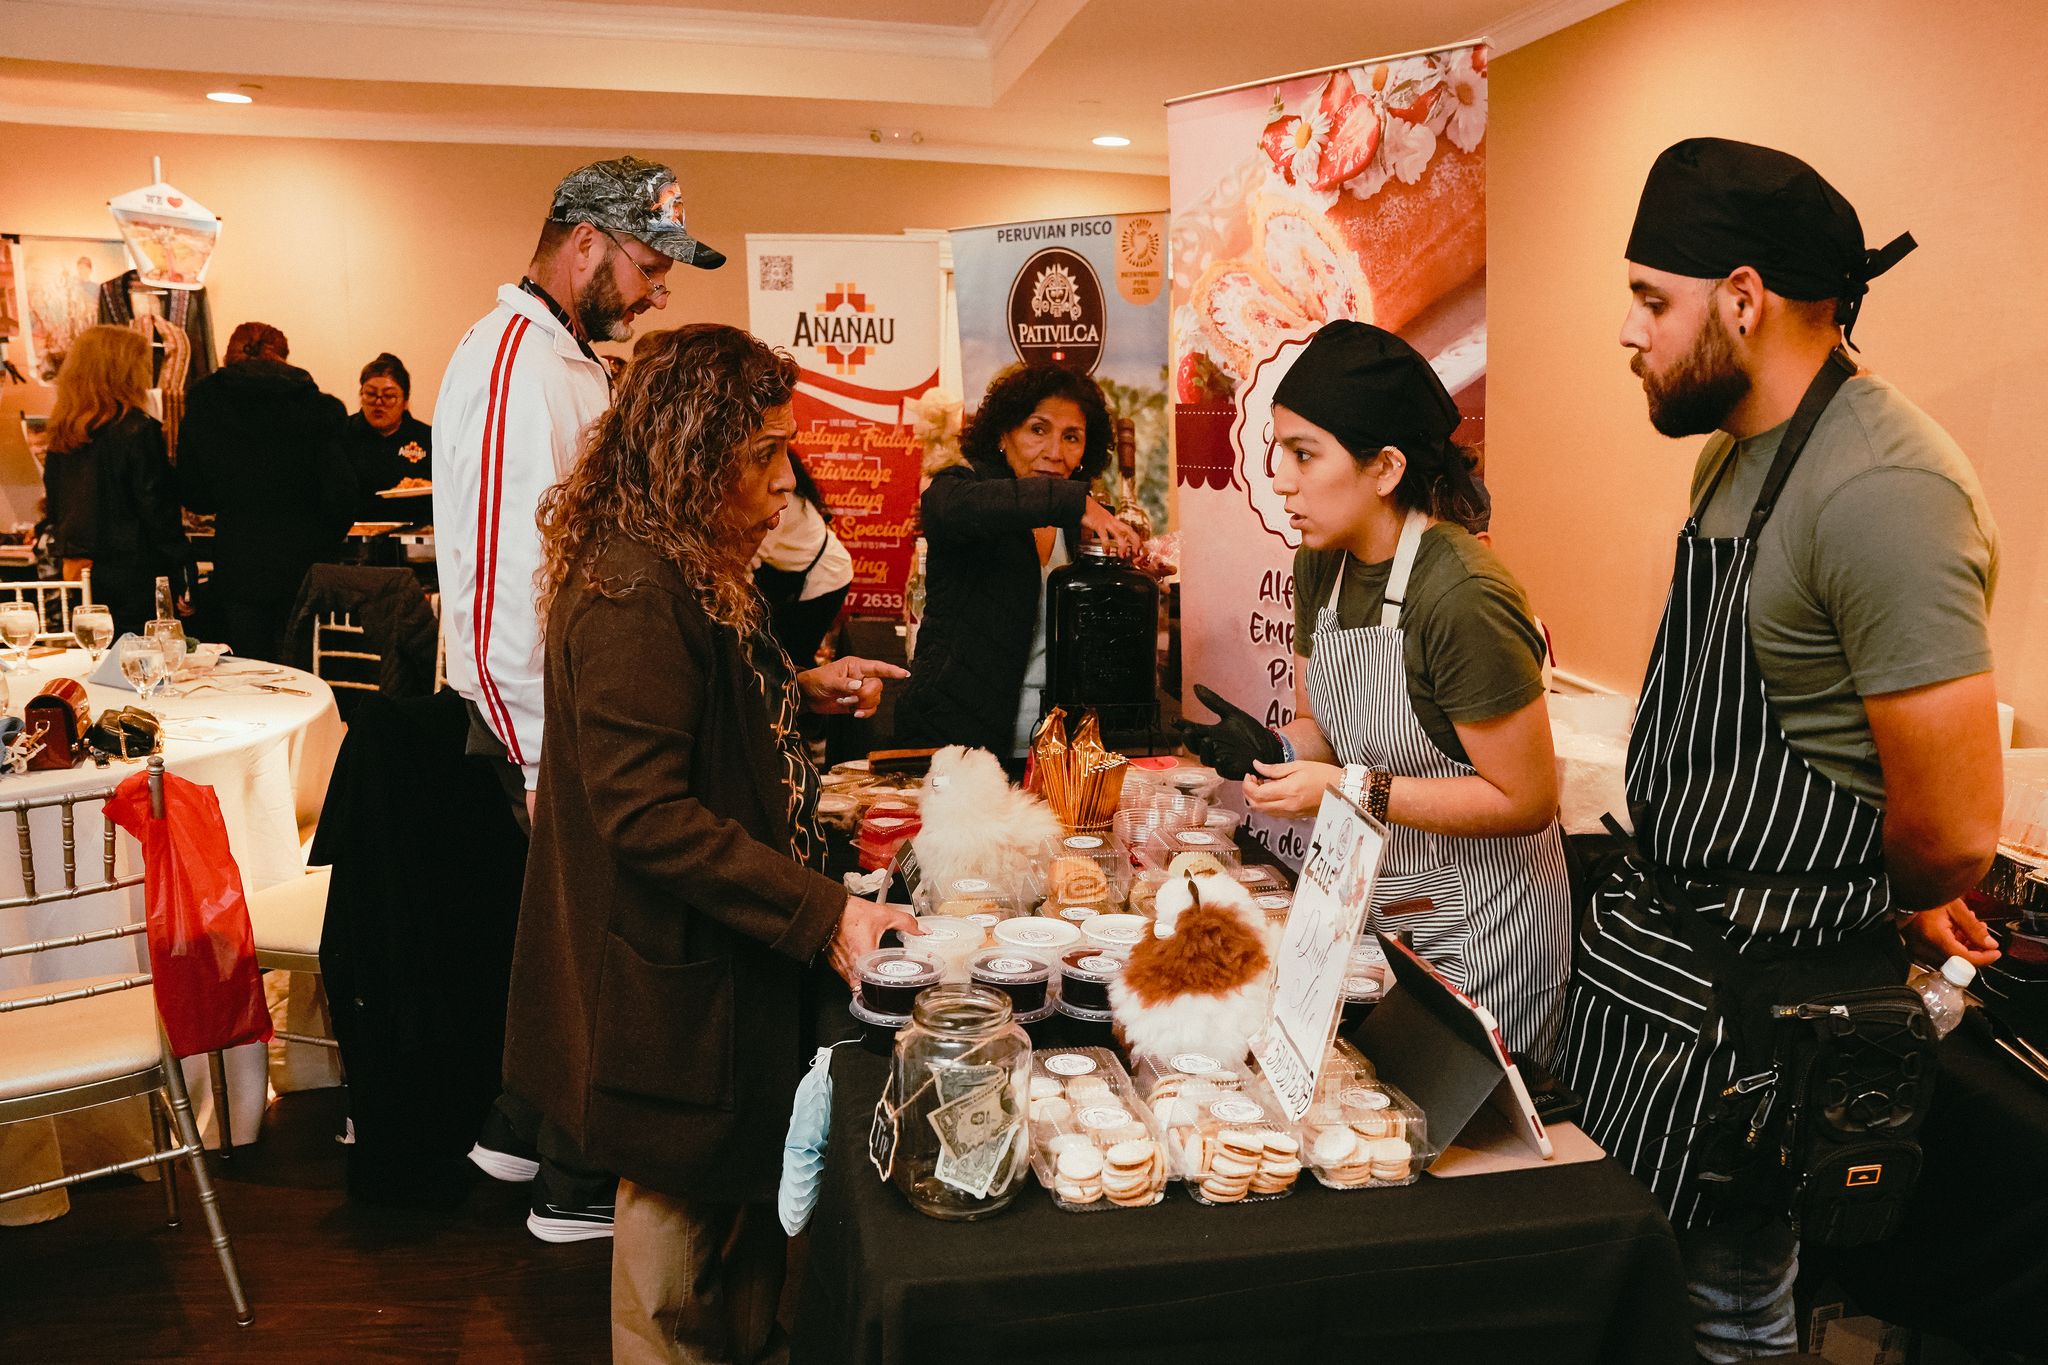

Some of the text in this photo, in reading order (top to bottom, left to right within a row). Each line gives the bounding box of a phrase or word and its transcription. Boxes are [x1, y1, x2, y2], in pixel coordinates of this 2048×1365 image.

[997, 220, 1112, 243] PERUVIAN PISCO
[1018, 323, 1100, 343] PATIVILCA
[824, 488, 885, 511] undays
[840, 516, 912, 541] Special
[862, 592, 903, 609] 2633
[1265, 699, 1296, 729] Ap
[1278, 827, 1306, 858] de
